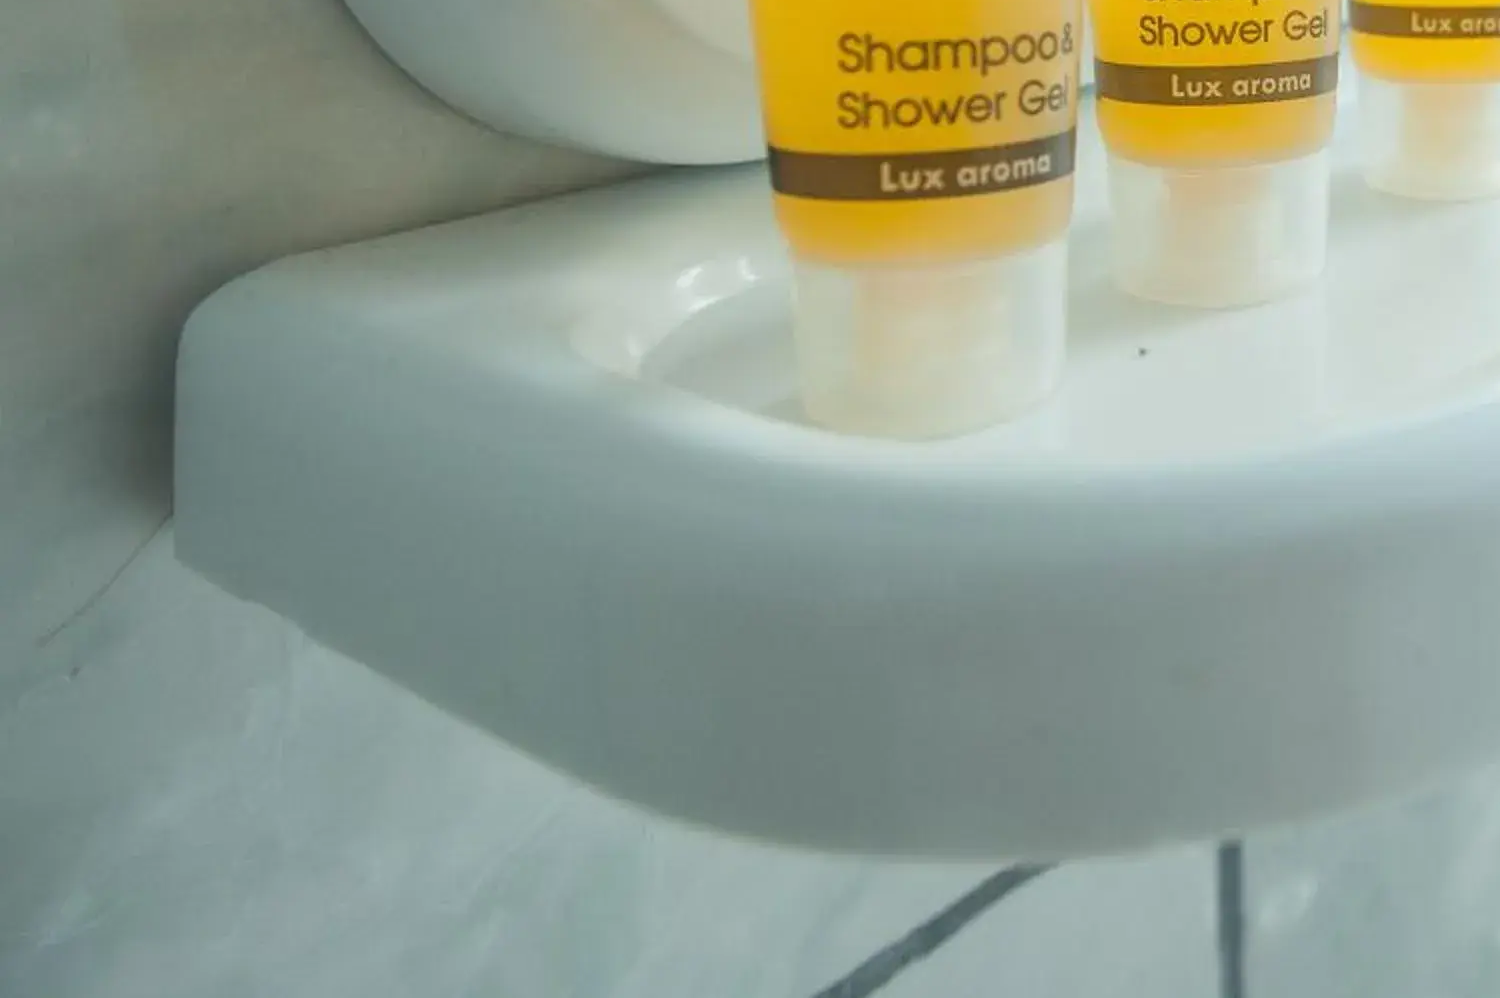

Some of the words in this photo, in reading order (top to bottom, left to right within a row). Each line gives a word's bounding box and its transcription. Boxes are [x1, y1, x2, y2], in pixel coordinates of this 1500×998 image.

[1139, 14, 1275, 46] Shower
[1283, 9, 1328, 41] Gel
[1411, 11, 1451, 33] Lux
[837, 90, 1007, 130] Shower
[1018, 75, 1070, 117] Gel
[1171, 74, 1223, 98] Lux
[1232, 72, 1312, 97] aroma
[880, 161, 946, 192] Lux
[957, 153, 1052, 188] aroma
